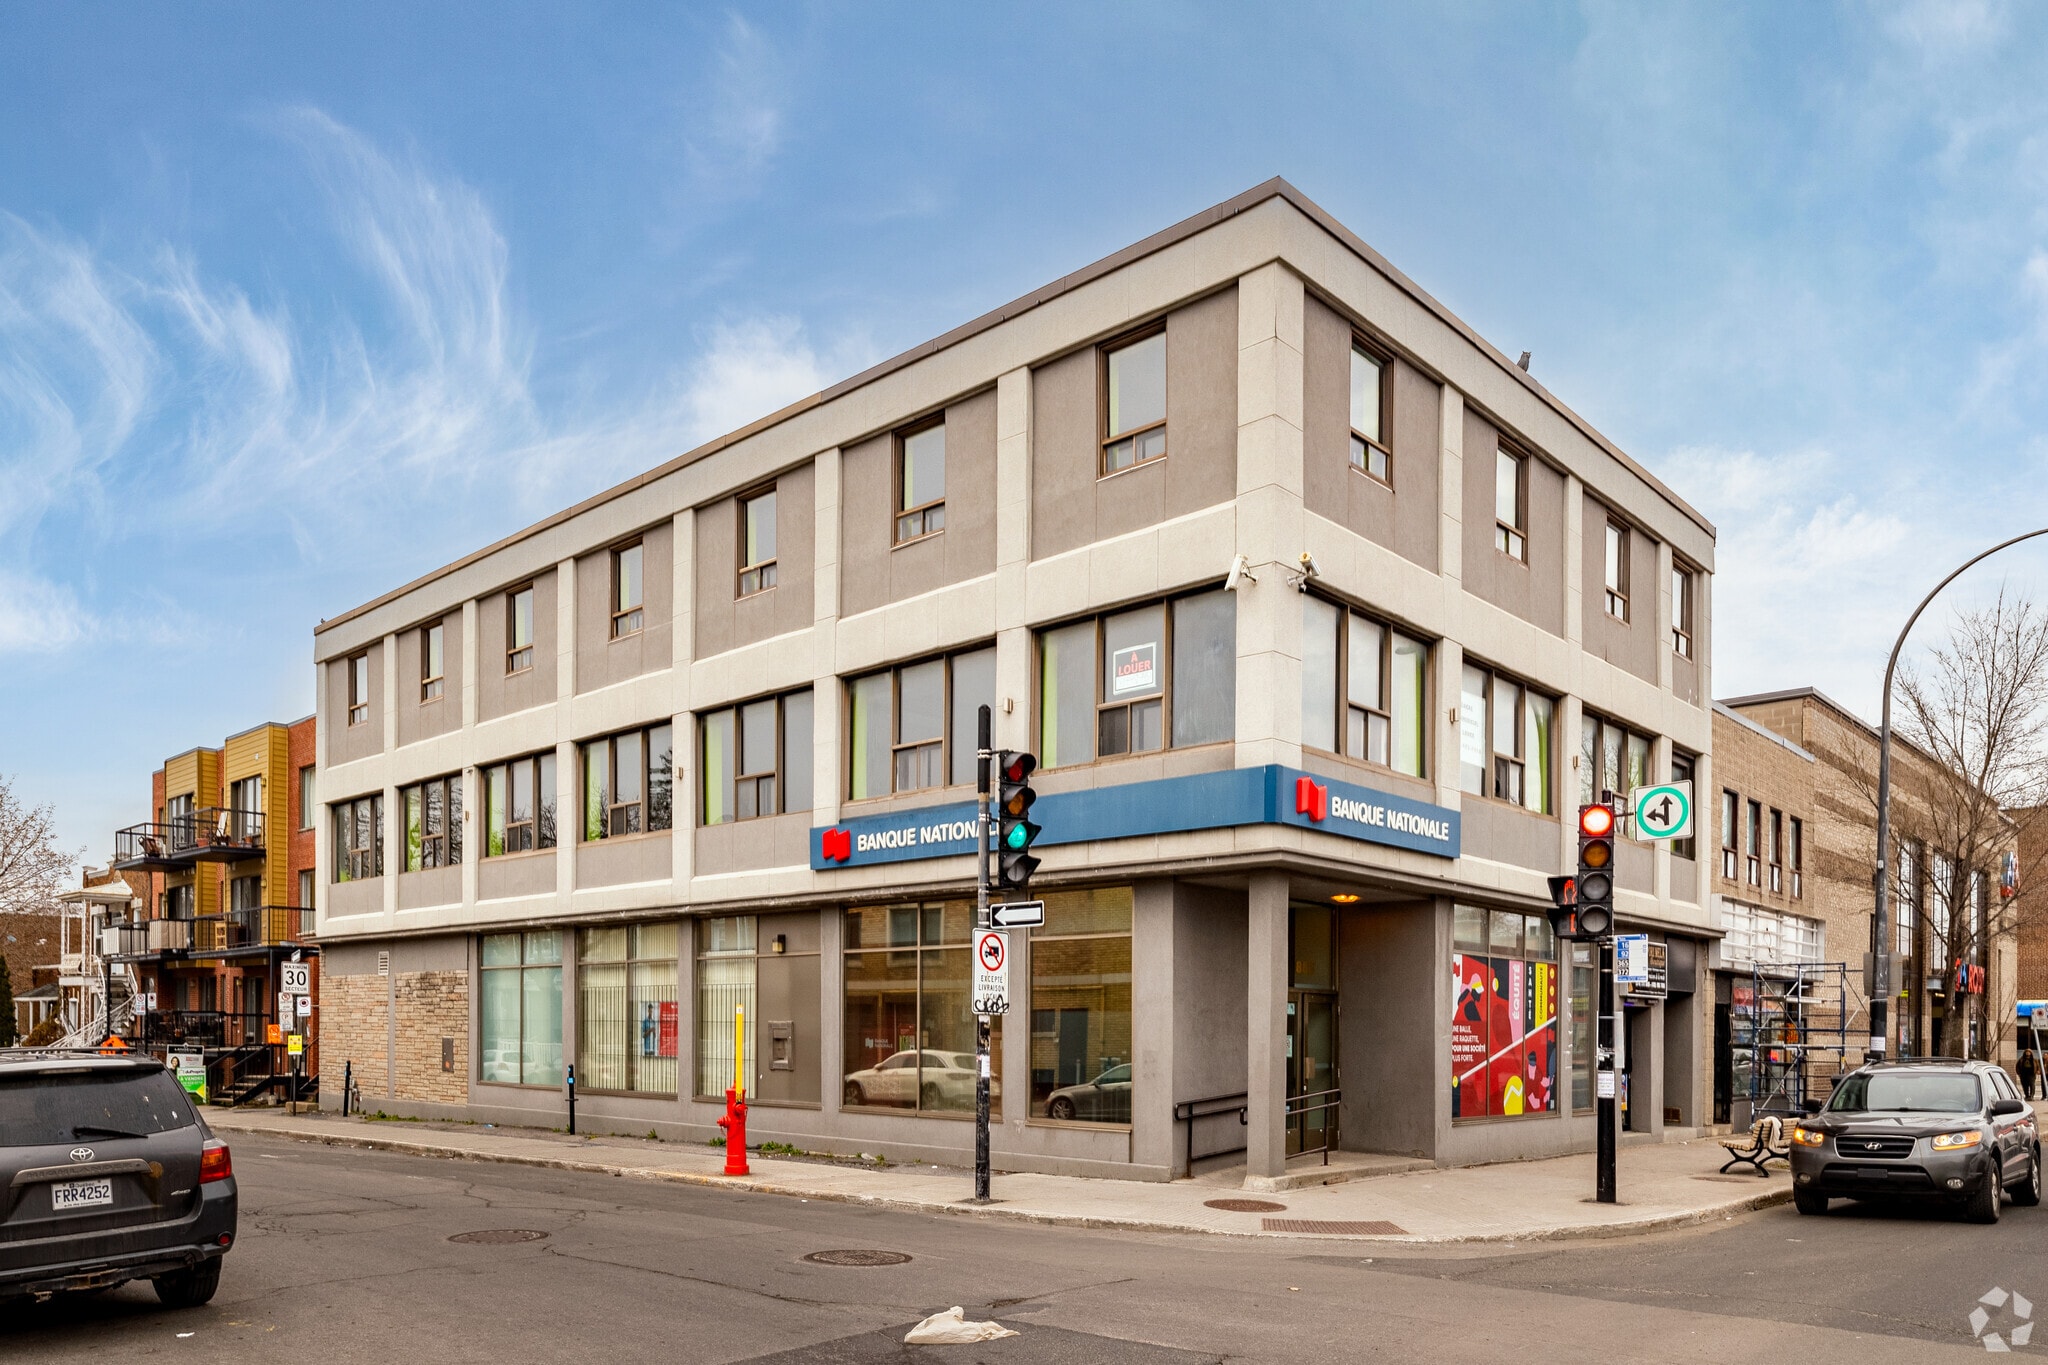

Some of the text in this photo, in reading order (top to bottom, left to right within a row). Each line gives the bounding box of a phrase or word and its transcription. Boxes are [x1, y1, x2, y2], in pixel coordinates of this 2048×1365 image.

[1118, 660, 1151, 676] LOUER
[1331, 796, 1449, 841] BANQUE NATIONALE
[857, 818, 1000, 852] BANQUE NATIONL
[285, 970, 307, 986] 30
[980, 974, 1003, 983] EXCEPTÉ
[978, 984, 1005, 992] LIVRAISON
[1512, 963, 1520, 1020] ÉQUITÉ
[26, 1163, 133, 1179] HIGHLANDER
[54, 1184, 111, 1204] FRR4252
